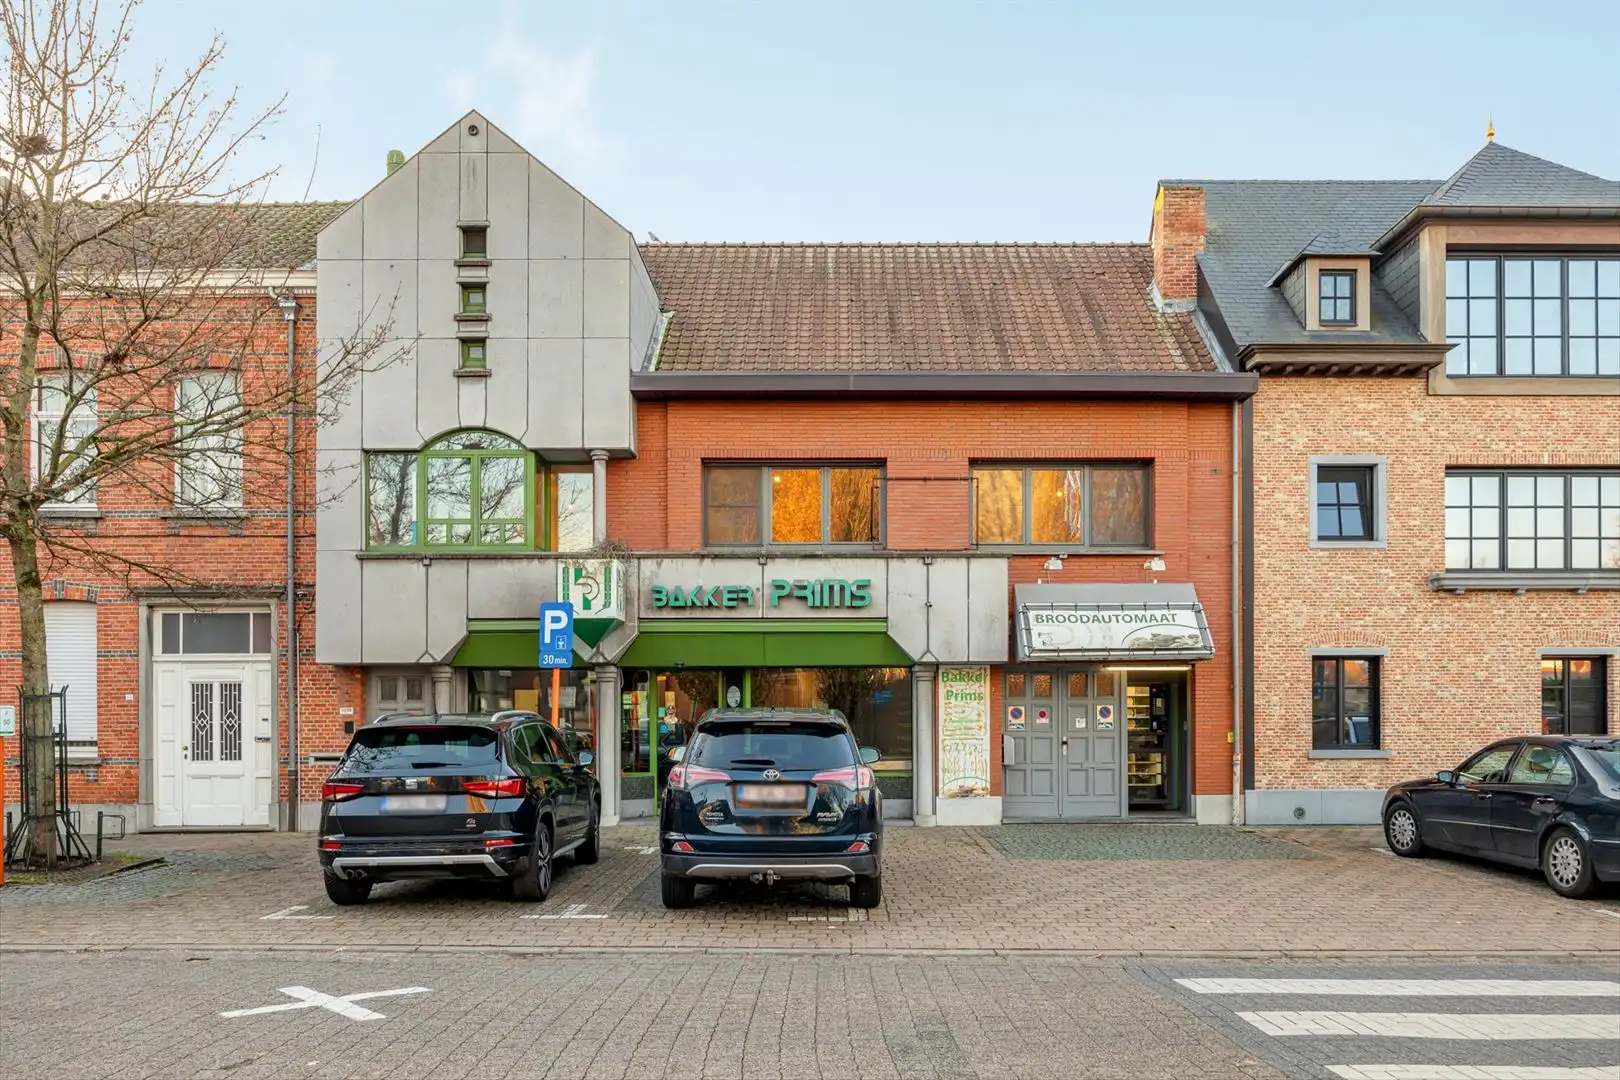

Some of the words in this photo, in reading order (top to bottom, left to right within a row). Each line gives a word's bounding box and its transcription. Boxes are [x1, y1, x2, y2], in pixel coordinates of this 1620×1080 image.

[651, 584, 755, 607] BAKKER
[1035, 613, 1177, 624] BROODAUTOMAAT
[544, 609, 568, 644] P
[543, 655, 554, 665] 30
[555, 656, 568, 665] min.
[942, 671, 988, 684] Bakker
[946, 690, 984, 701] Prims
